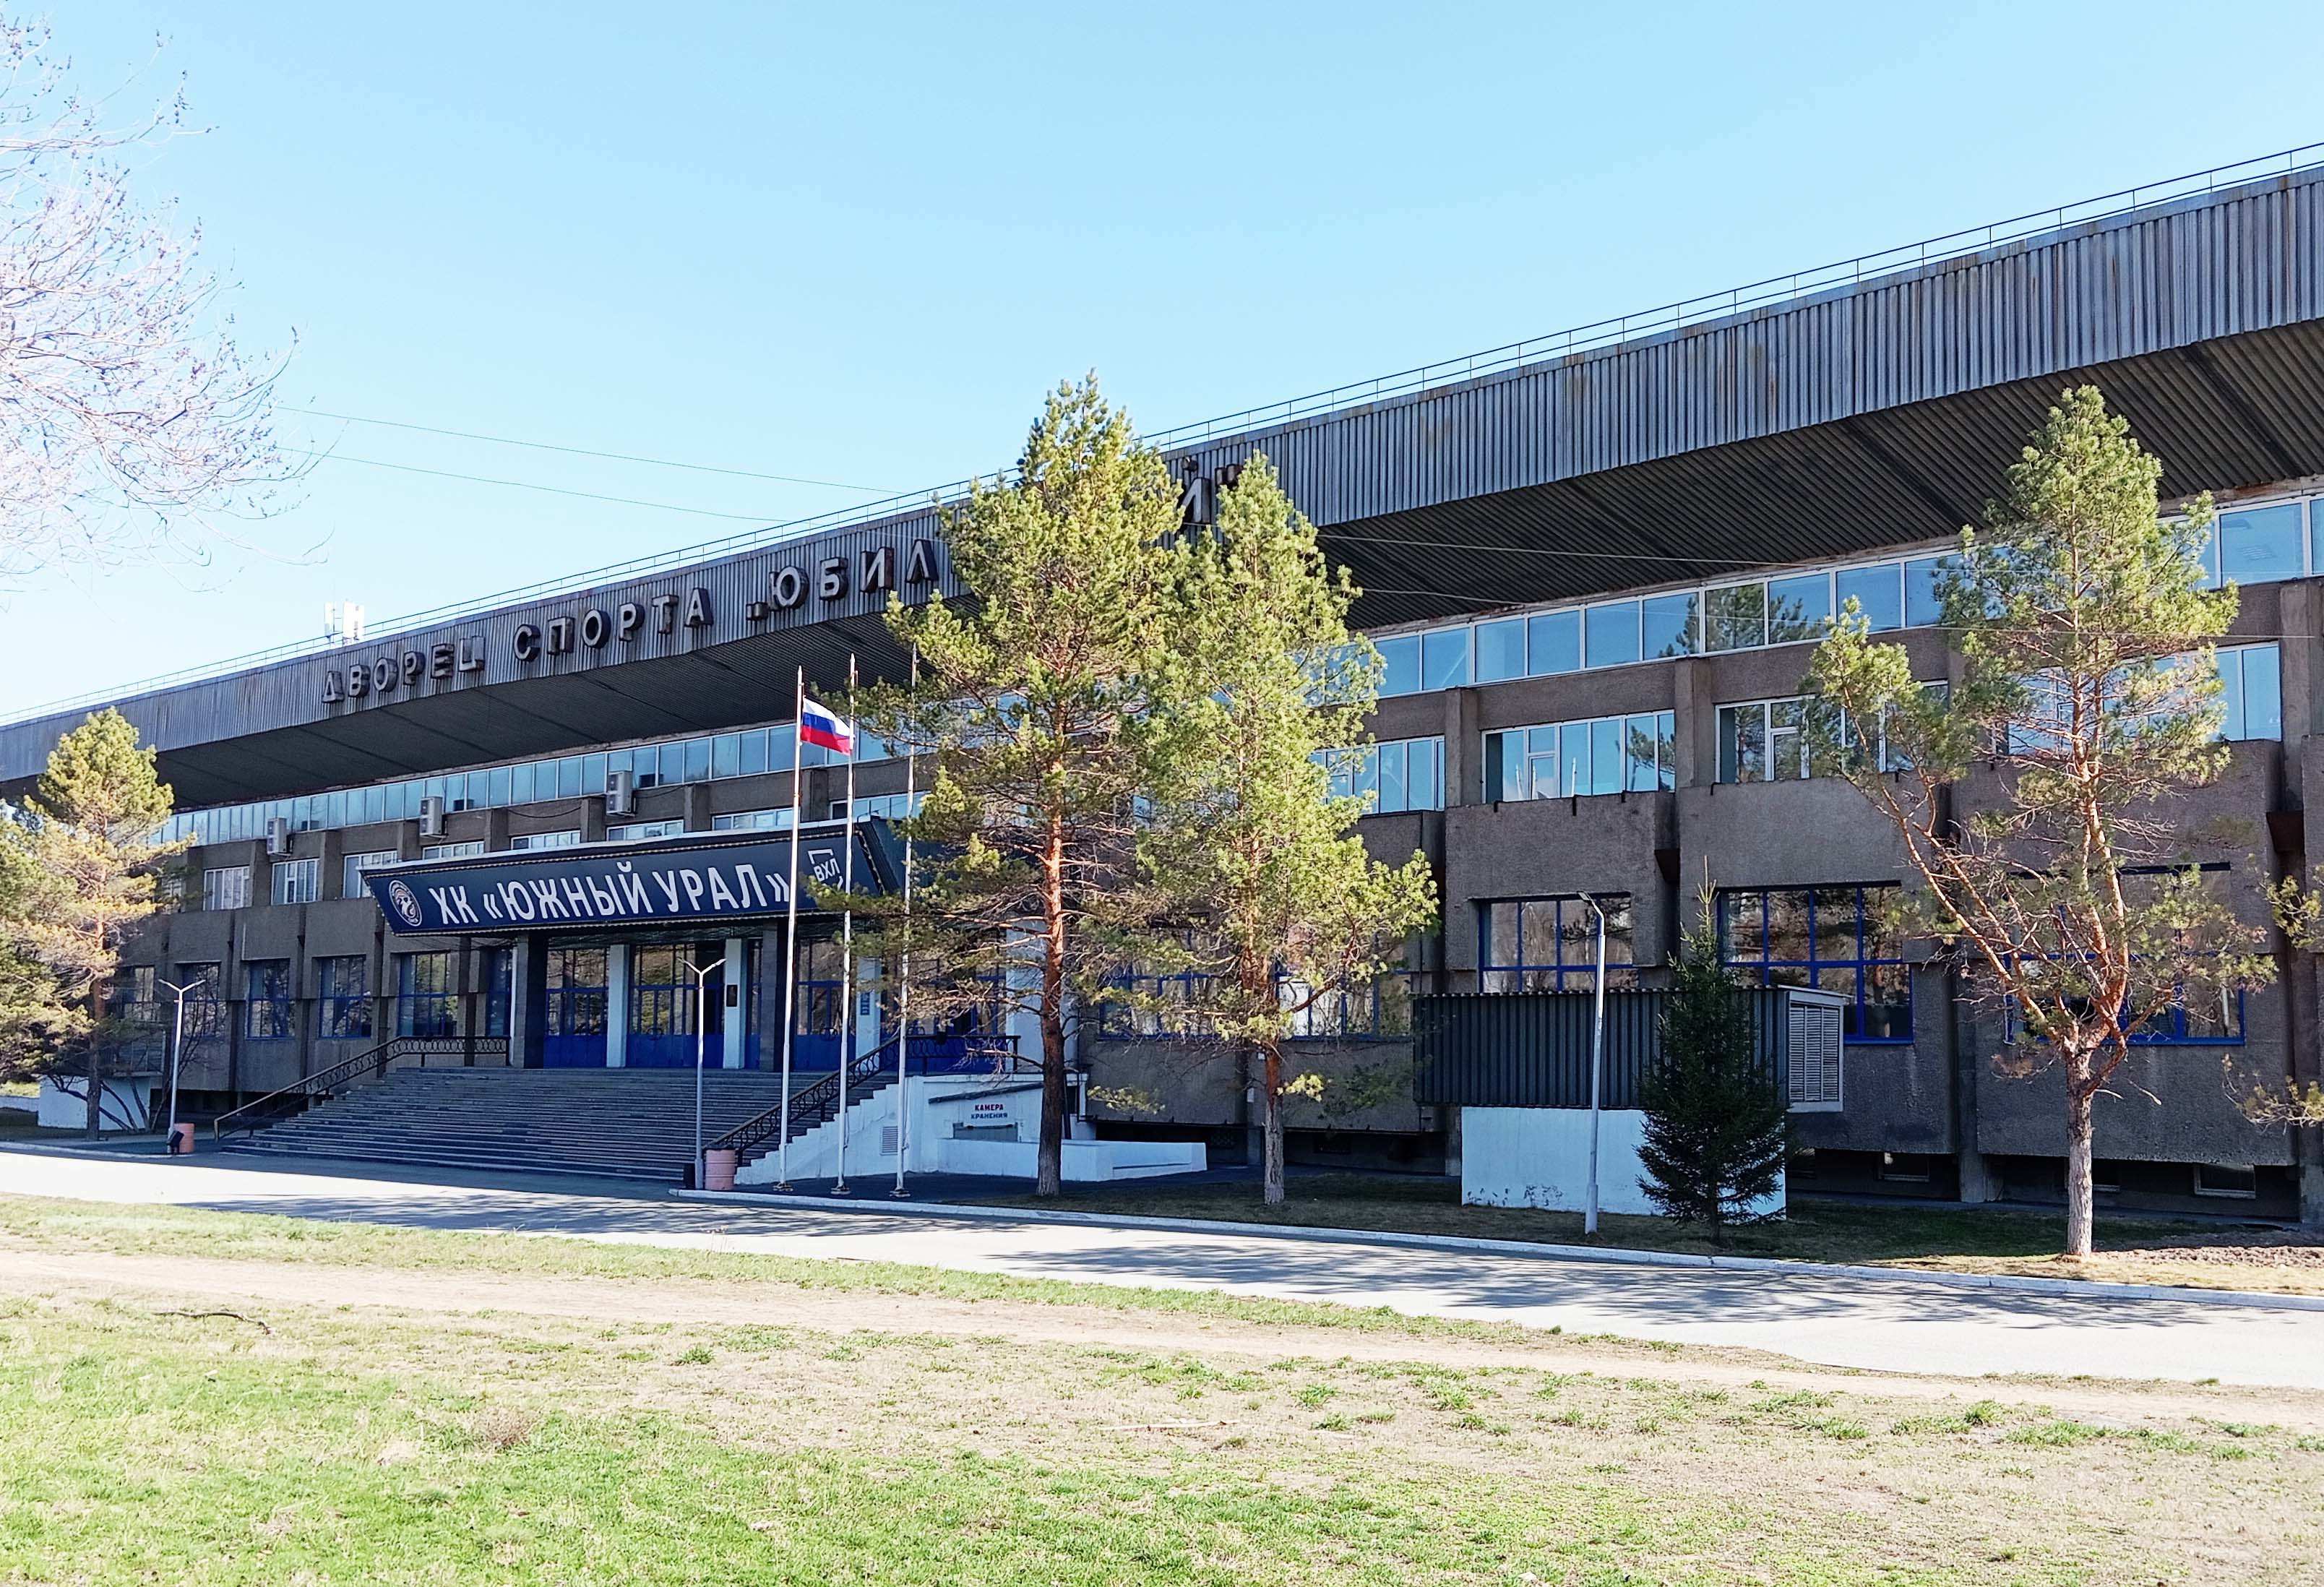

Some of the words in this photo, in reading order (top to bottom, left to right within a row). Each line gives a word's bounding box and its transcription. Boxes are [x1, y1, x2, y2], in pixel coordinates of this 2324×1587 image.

[322, 635, 486, 704] ДВОРЕЦ
[513, 586, 714, 663] СПОРТА
[428, 885, 480, 925] ХК
[483, 861, 654, 921] «ЮЖНЫЙ
[651, 864, 790, 913] УРАЛ»
[813, 857, 840, 882] ВХЛ
